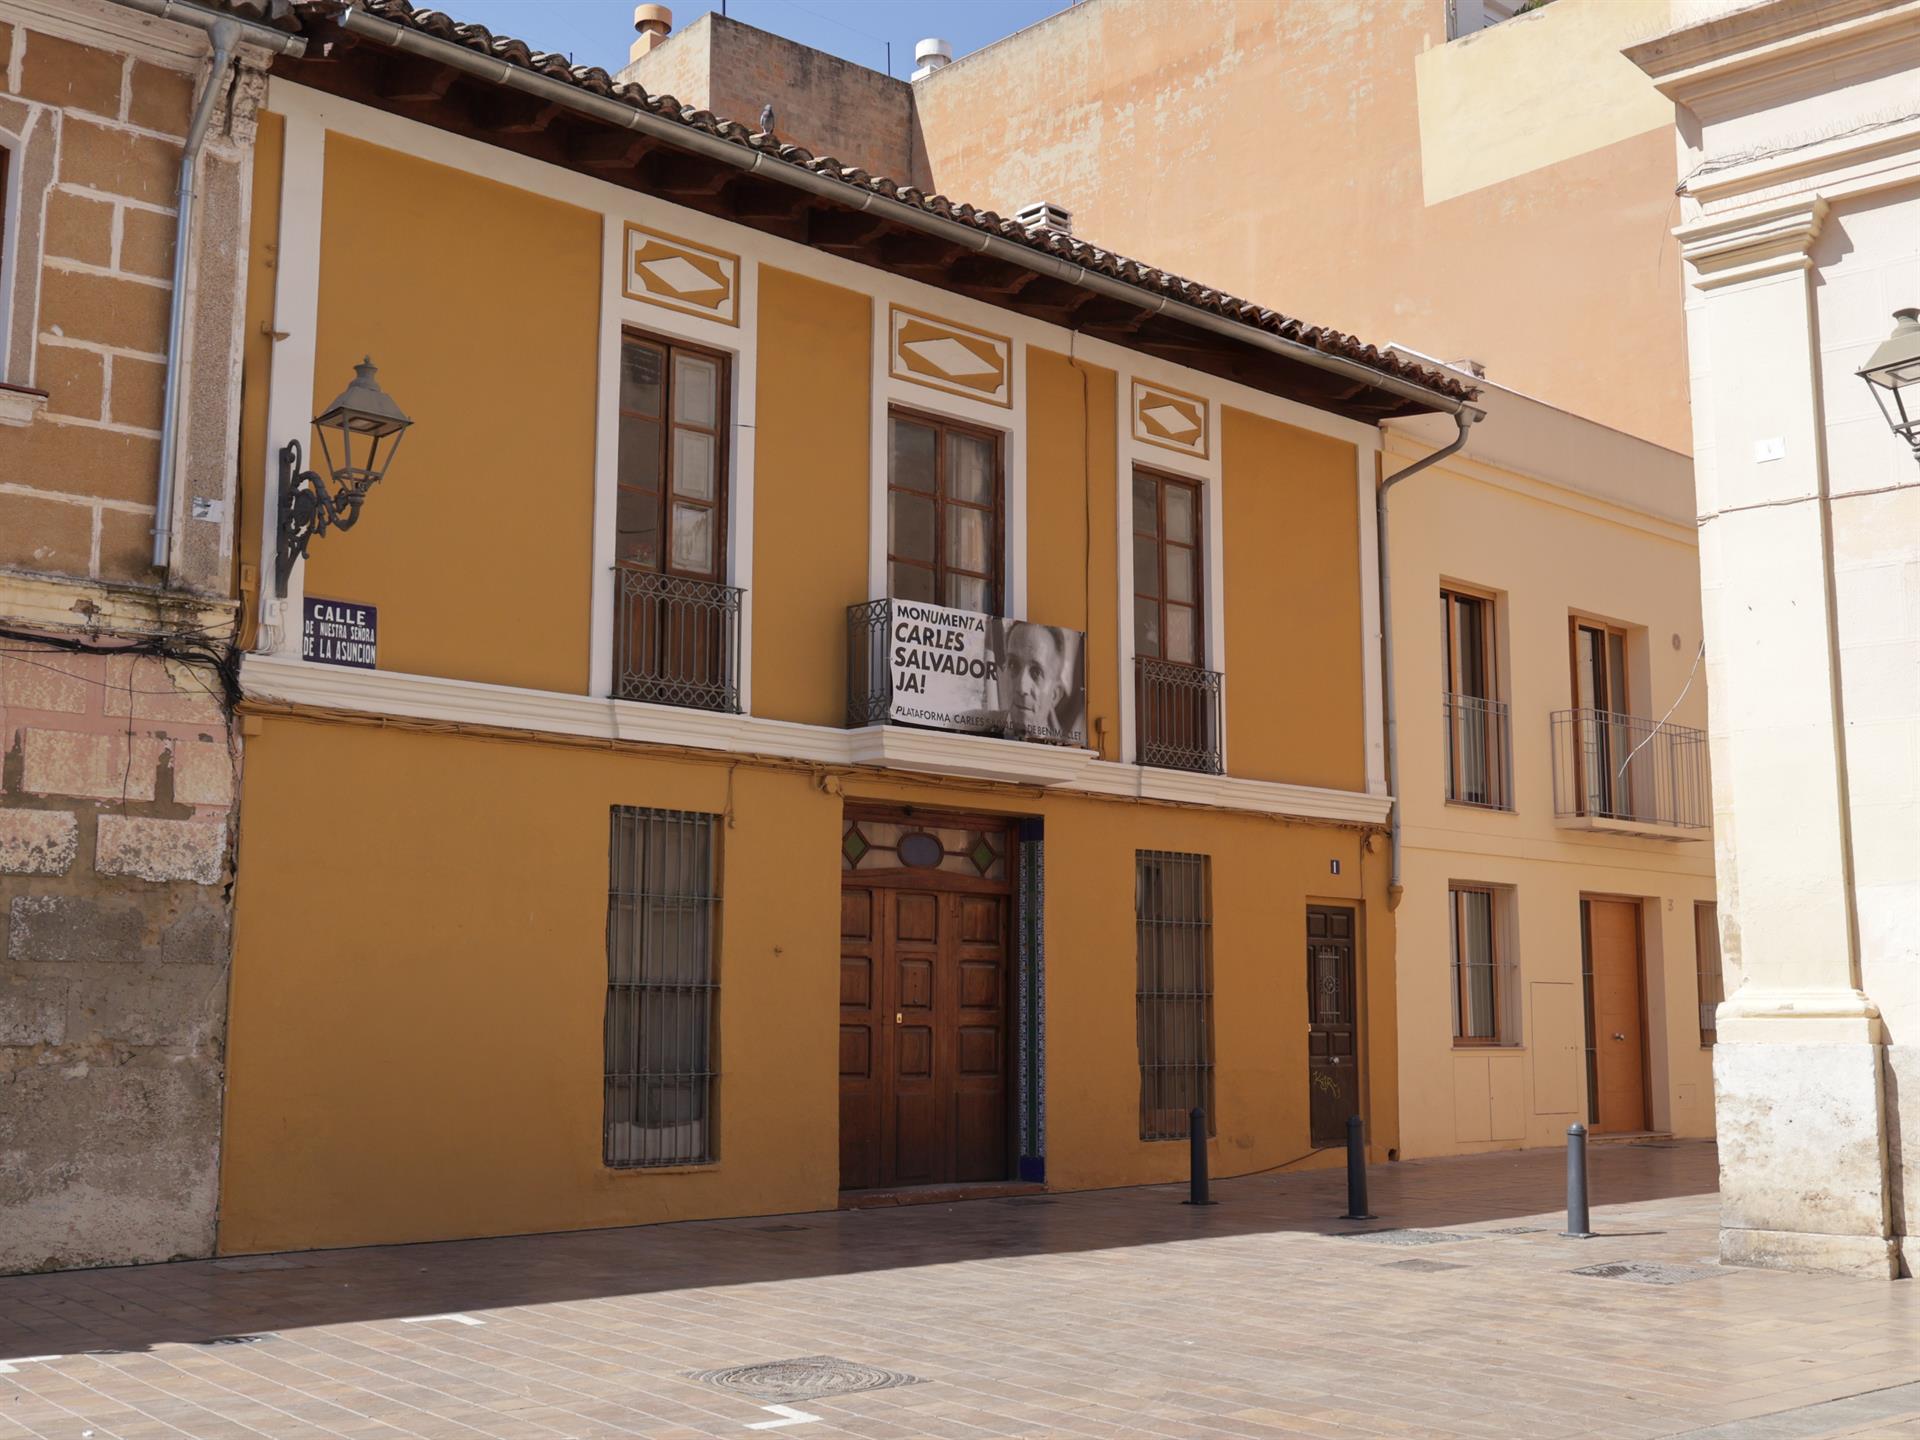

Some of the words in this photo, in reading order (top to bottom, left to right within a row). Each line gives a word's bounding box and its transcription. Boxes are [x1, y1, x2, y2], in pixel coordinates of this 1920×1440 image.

[314, 604, 366, 625] CALLE
[305, 620, 314, 635] DE
[320, 621, 347, 639] NUESTRA
[350, 625, 375, 643] SEÑORA
[895, 622, 965, 652] CARLES
[303, 636, 314, 656] DE
[320, 638, 331, 659] LA
[335, 641, 376, 664] ASUNCION
[894, 646, 998, 681] SALVADOR
[895, 671, 926, 694] JA!
[896, 705, 951, 723] PLATAFORMA
[953, 713, 985, 727] CARLES
[1667, 899, 1674, 911] 3
